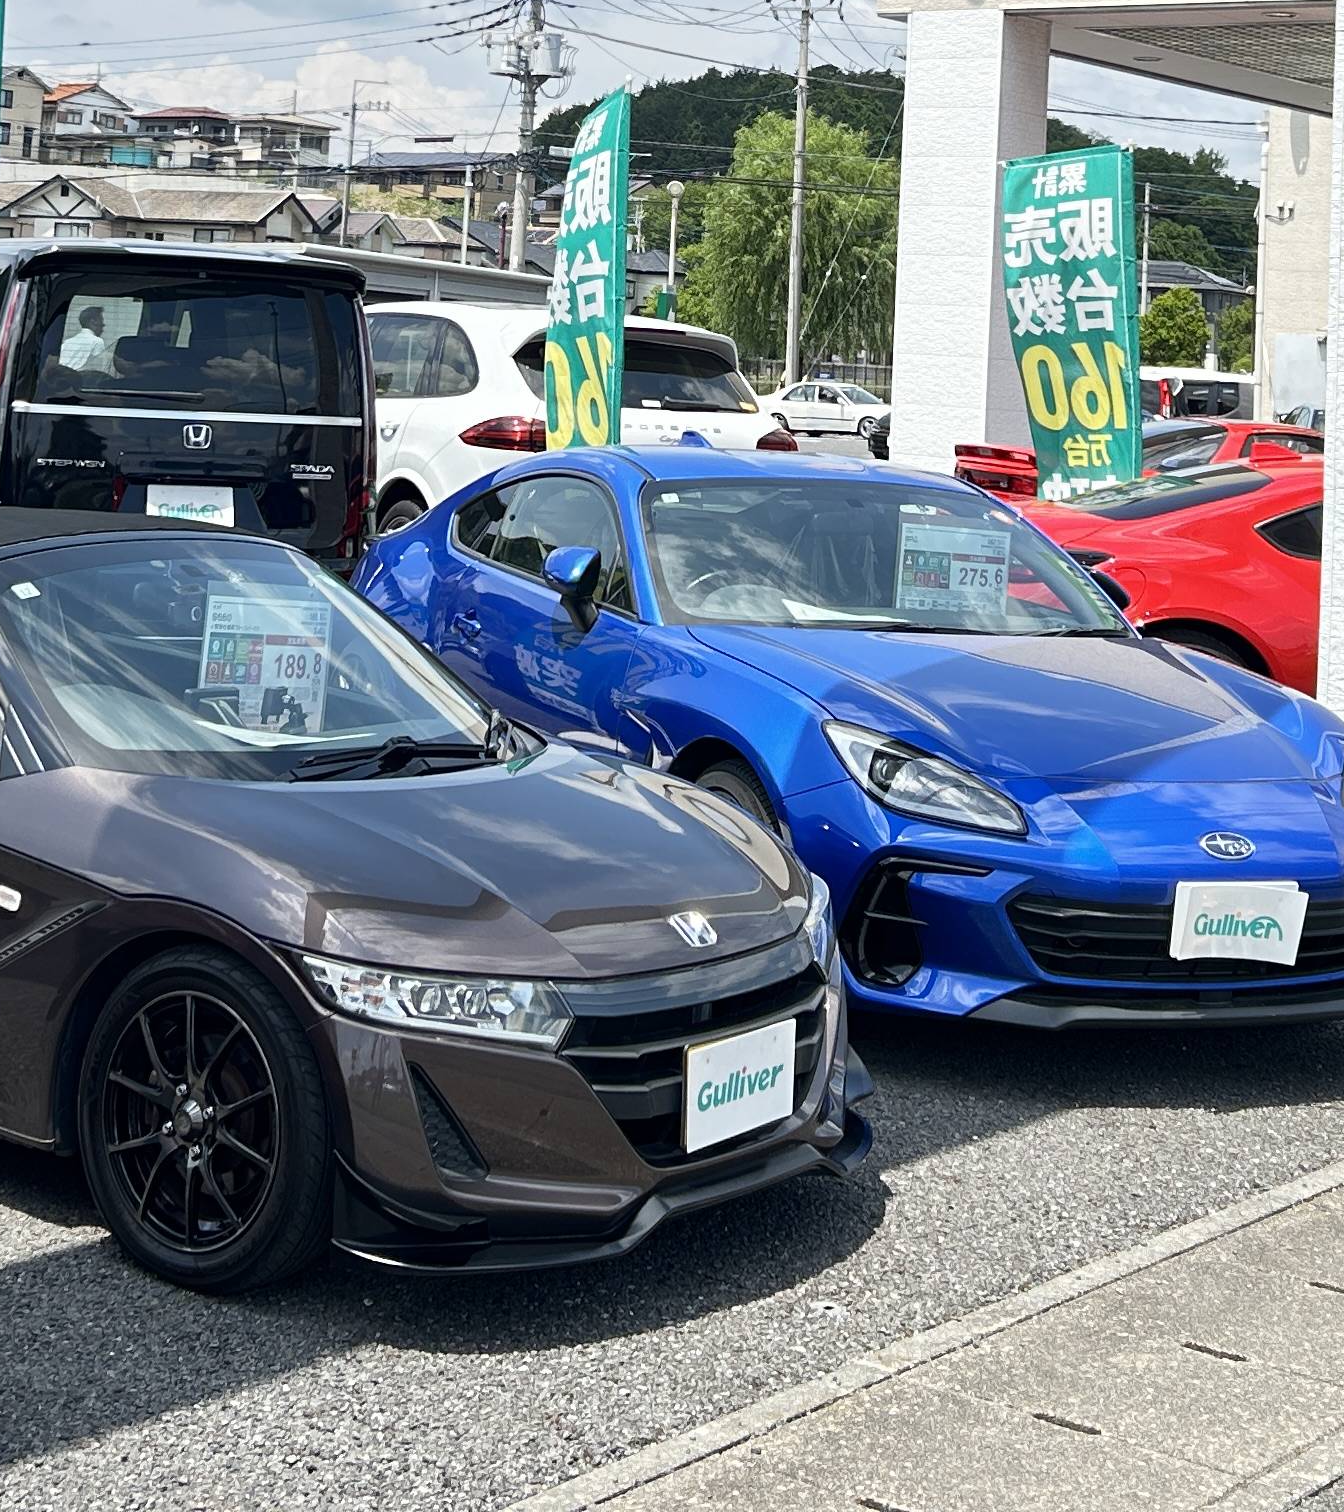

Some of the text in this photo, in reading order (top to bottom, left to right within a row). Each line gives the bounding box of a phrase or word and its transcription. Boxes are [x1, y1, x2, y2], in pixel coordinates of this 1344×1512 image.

[290, 464, 336, 474] SPADA
[158, 501, 224, 520] Gulliver
[958, 567, 1004, 588] 275.6
[273, 651, 323, 680] 189.8
[1194, 912, 1284, 942] Gulliver
[697, 1063, 785, 1113] Gulliver
